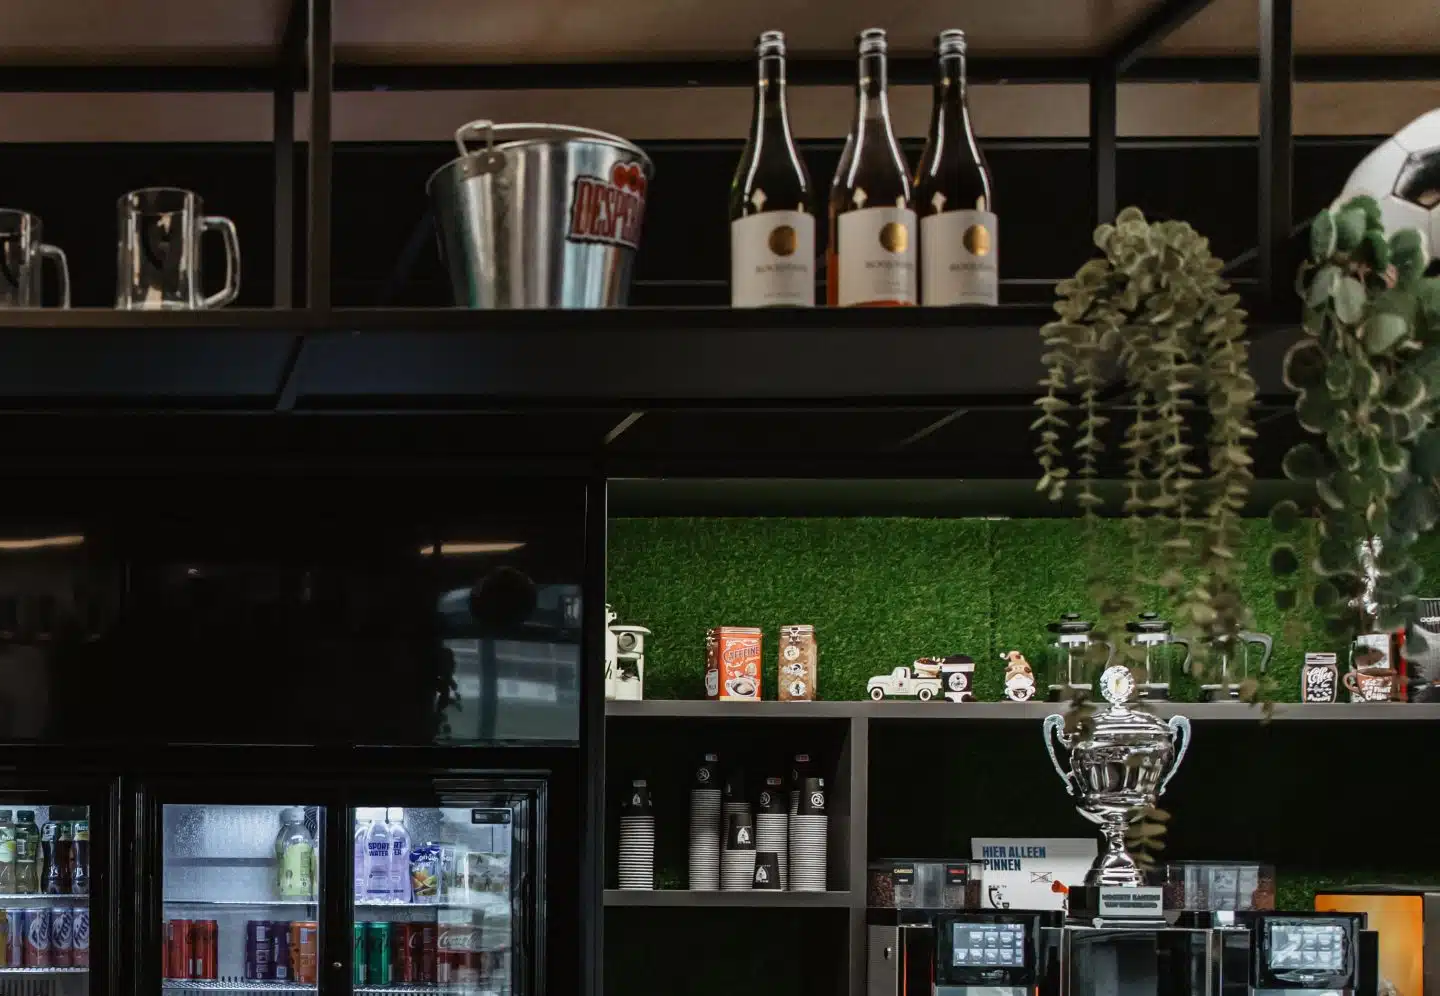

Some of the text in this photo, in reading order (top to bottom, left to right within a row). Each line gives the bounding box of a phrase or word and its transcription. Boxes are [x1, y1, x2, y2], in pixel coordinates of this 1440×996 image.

[368, 841, 389, 850] SPORT
[982, 846, 1046, 859] HIER ALLEEN
[983, 859, 1021, 871] PINNEN
